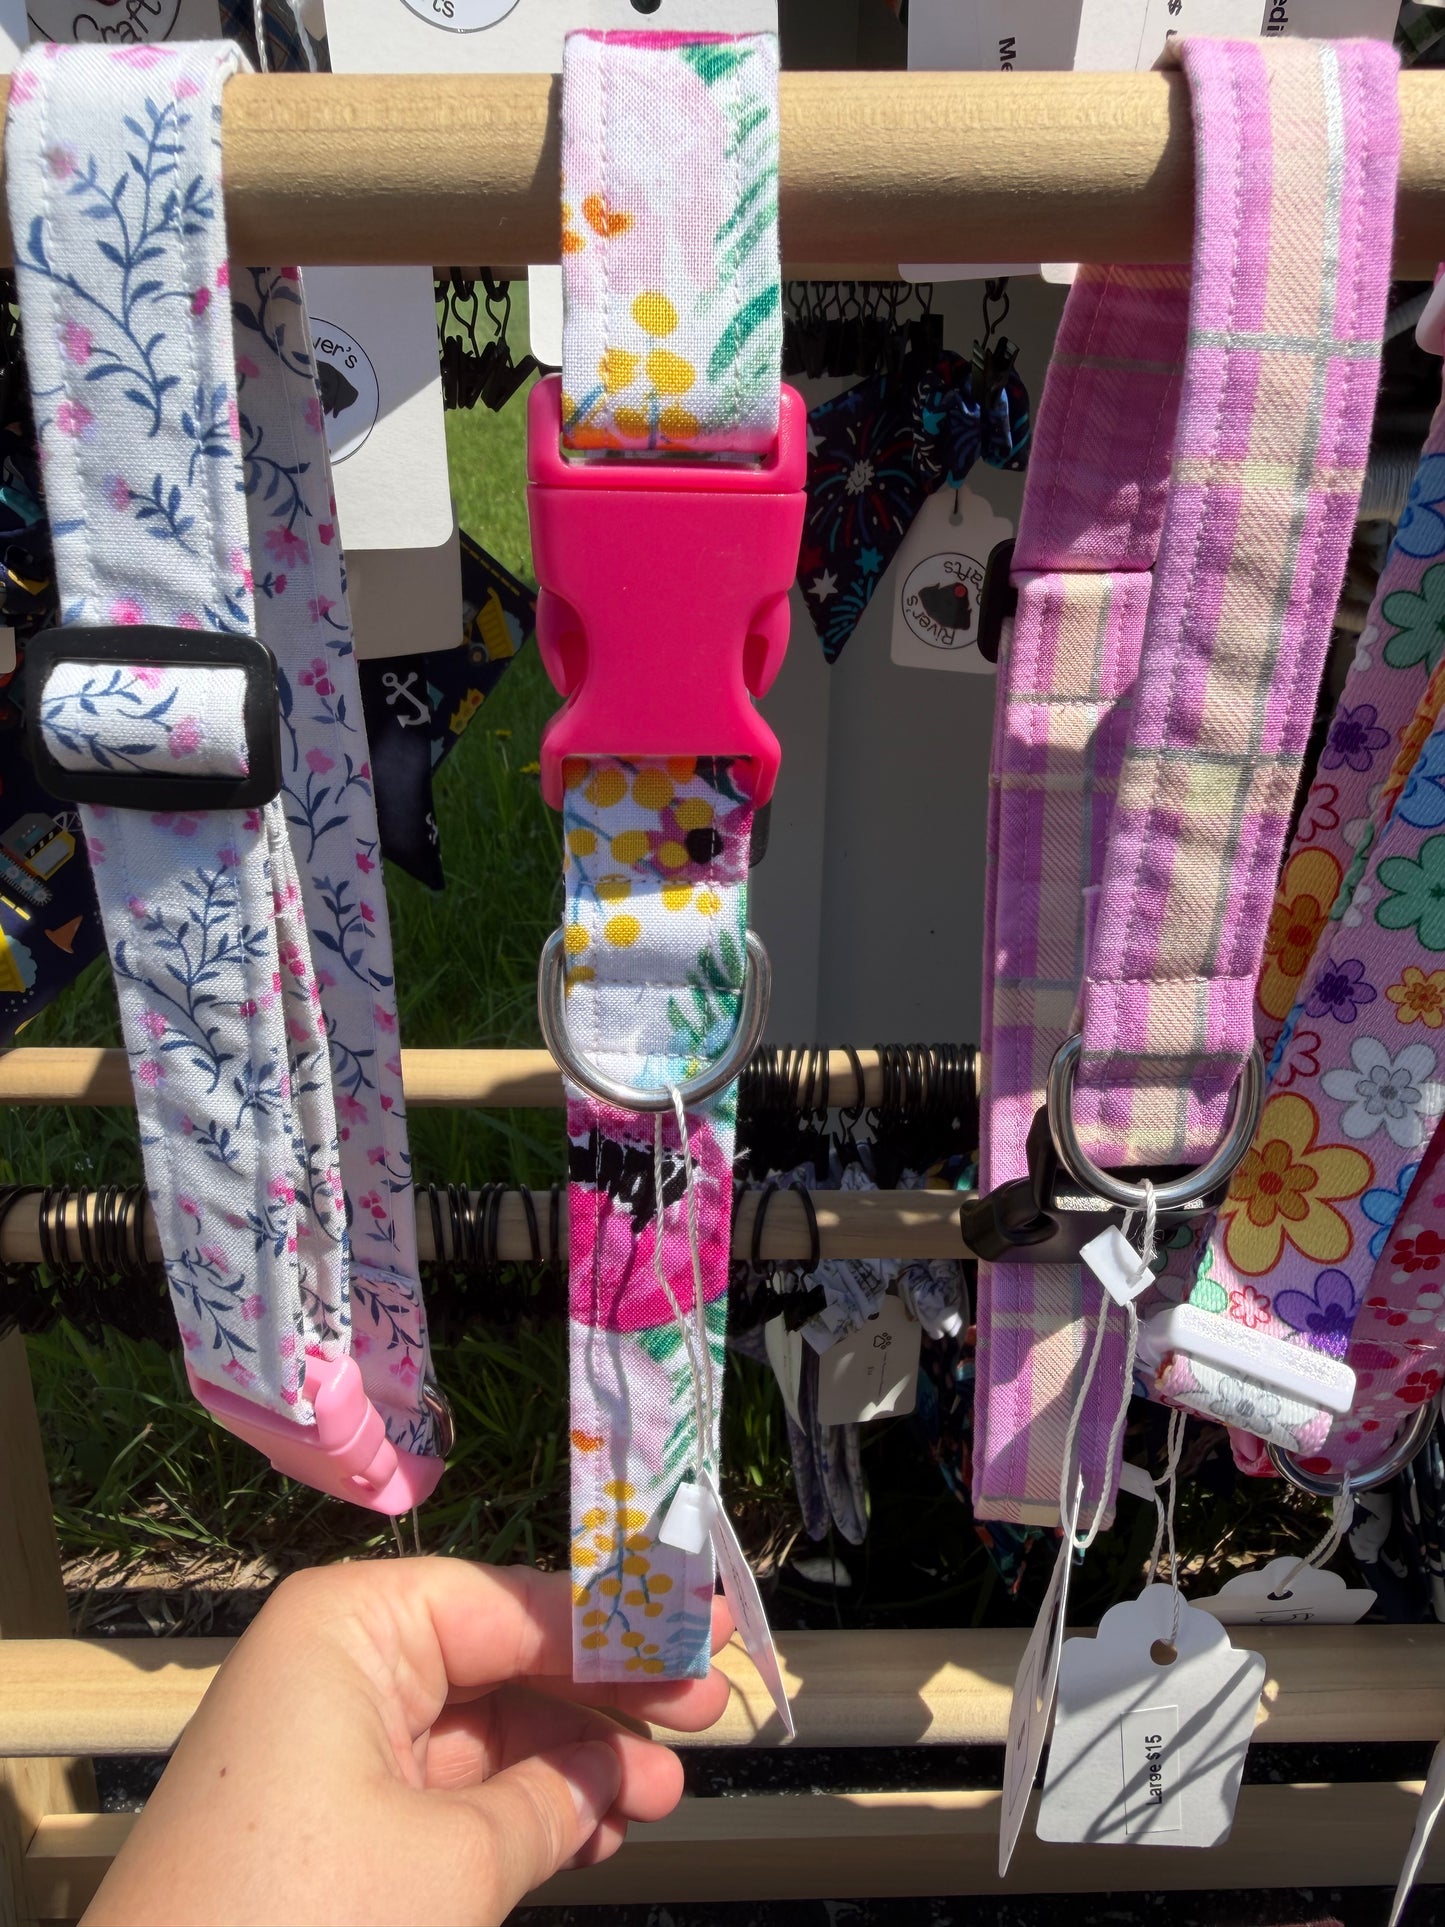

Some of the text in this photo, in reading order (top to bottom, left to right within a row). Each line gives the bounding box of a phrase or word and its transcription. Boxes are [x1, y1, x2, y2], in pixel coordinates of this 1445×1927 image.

[906, 595, 956, 646] River's
[1144, 1734, 1163, 1806] Large $15
